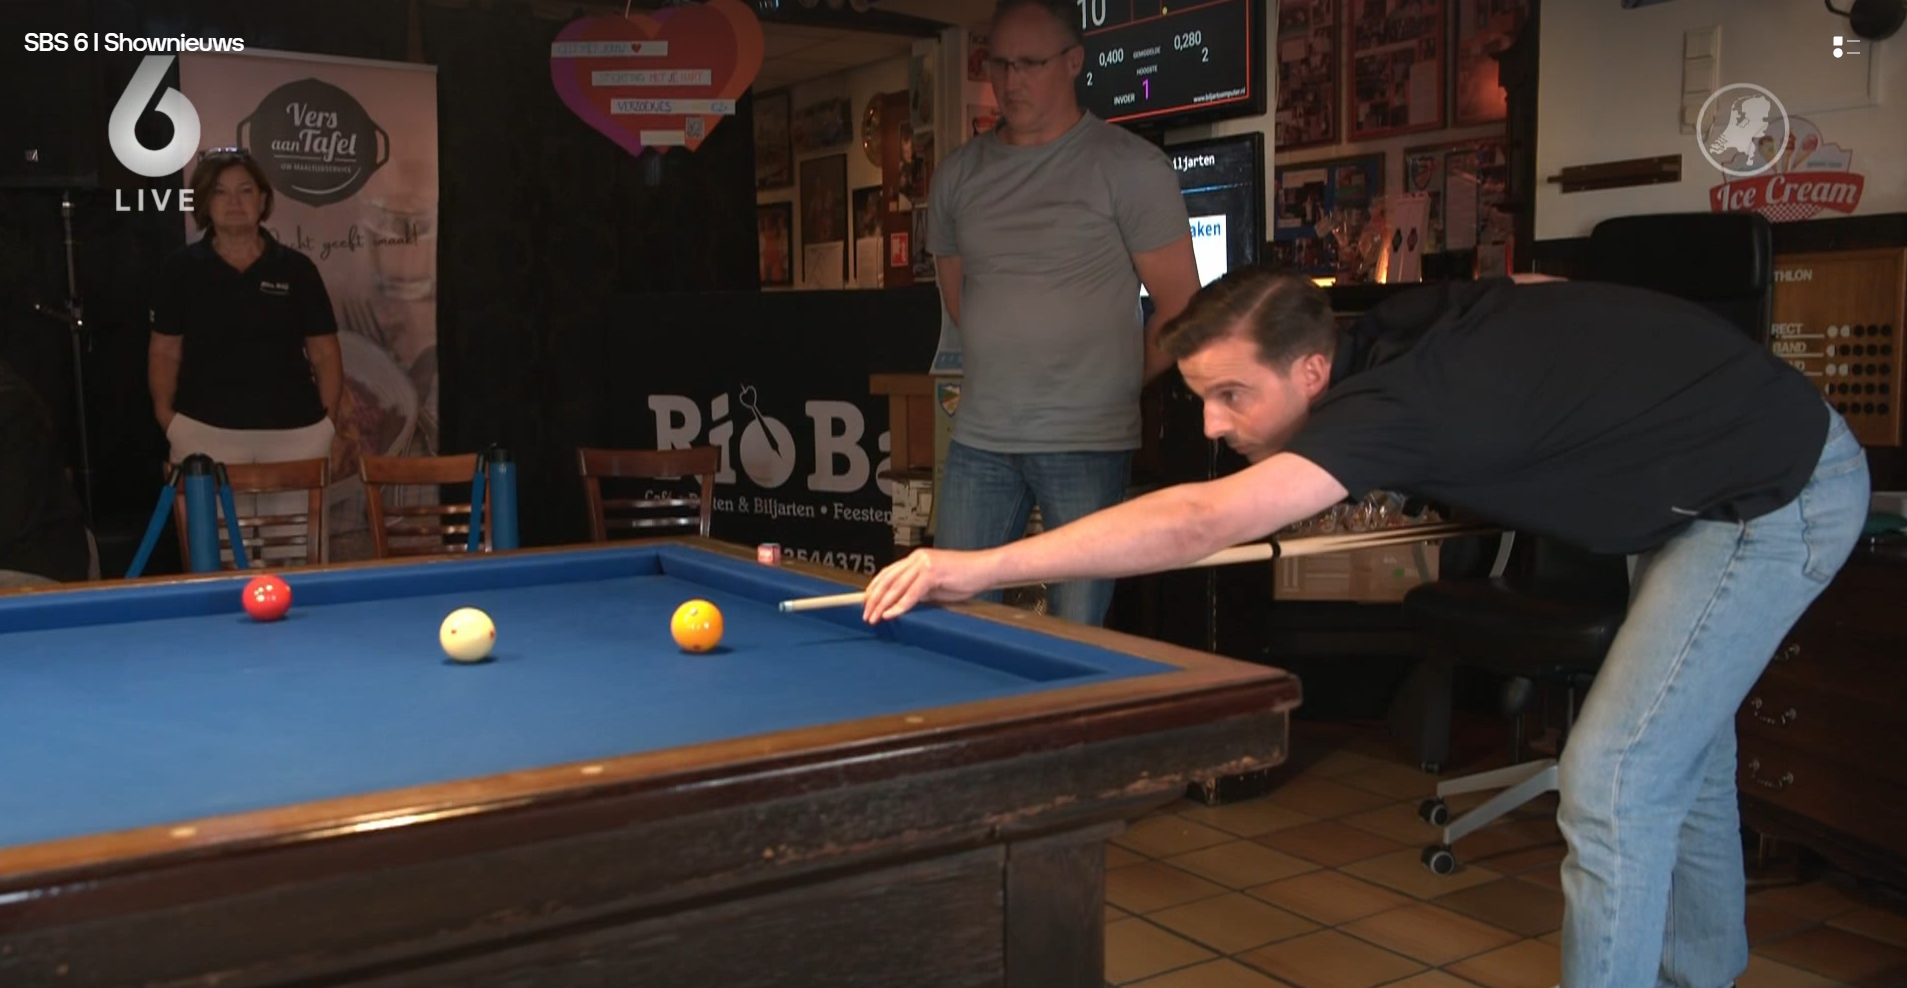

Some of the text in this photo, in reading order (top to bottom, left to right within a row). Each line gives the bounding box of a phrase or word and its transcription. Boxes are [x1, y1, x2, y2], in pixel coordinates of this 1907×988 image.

[1099, 48, 1124, 67] 0,400
[1174, 30, 1202, 51] 0,280
[1086, 72, 1093, 86] 2
[1202, 47, 1209, 62] 2
[1113, 78, 1149, 105] INVOER 1
[286, 102, 338, 129] Vers
[617, 101, 673, 113] VERZOEKJES
[271, 128, 357, 162] aan Tafel
[1173, 154, 1215, 172] iljarten
[1716, 176, 1858, 211] Ice Cream
[320, 225, 365, 260] geeft
[1190, 221, 1221, 238] aken
[1773, 269, 1813, 283] THLON
[1771, 322, 1804, 336] RECT
[648, 393, 796, 489] Rio
[688, 491, 734, 513] Dten
[738, 497, 750, 513] &
[753, 497, 815, 519] Biljarten
[833, 503, 892, 523] Feesten
